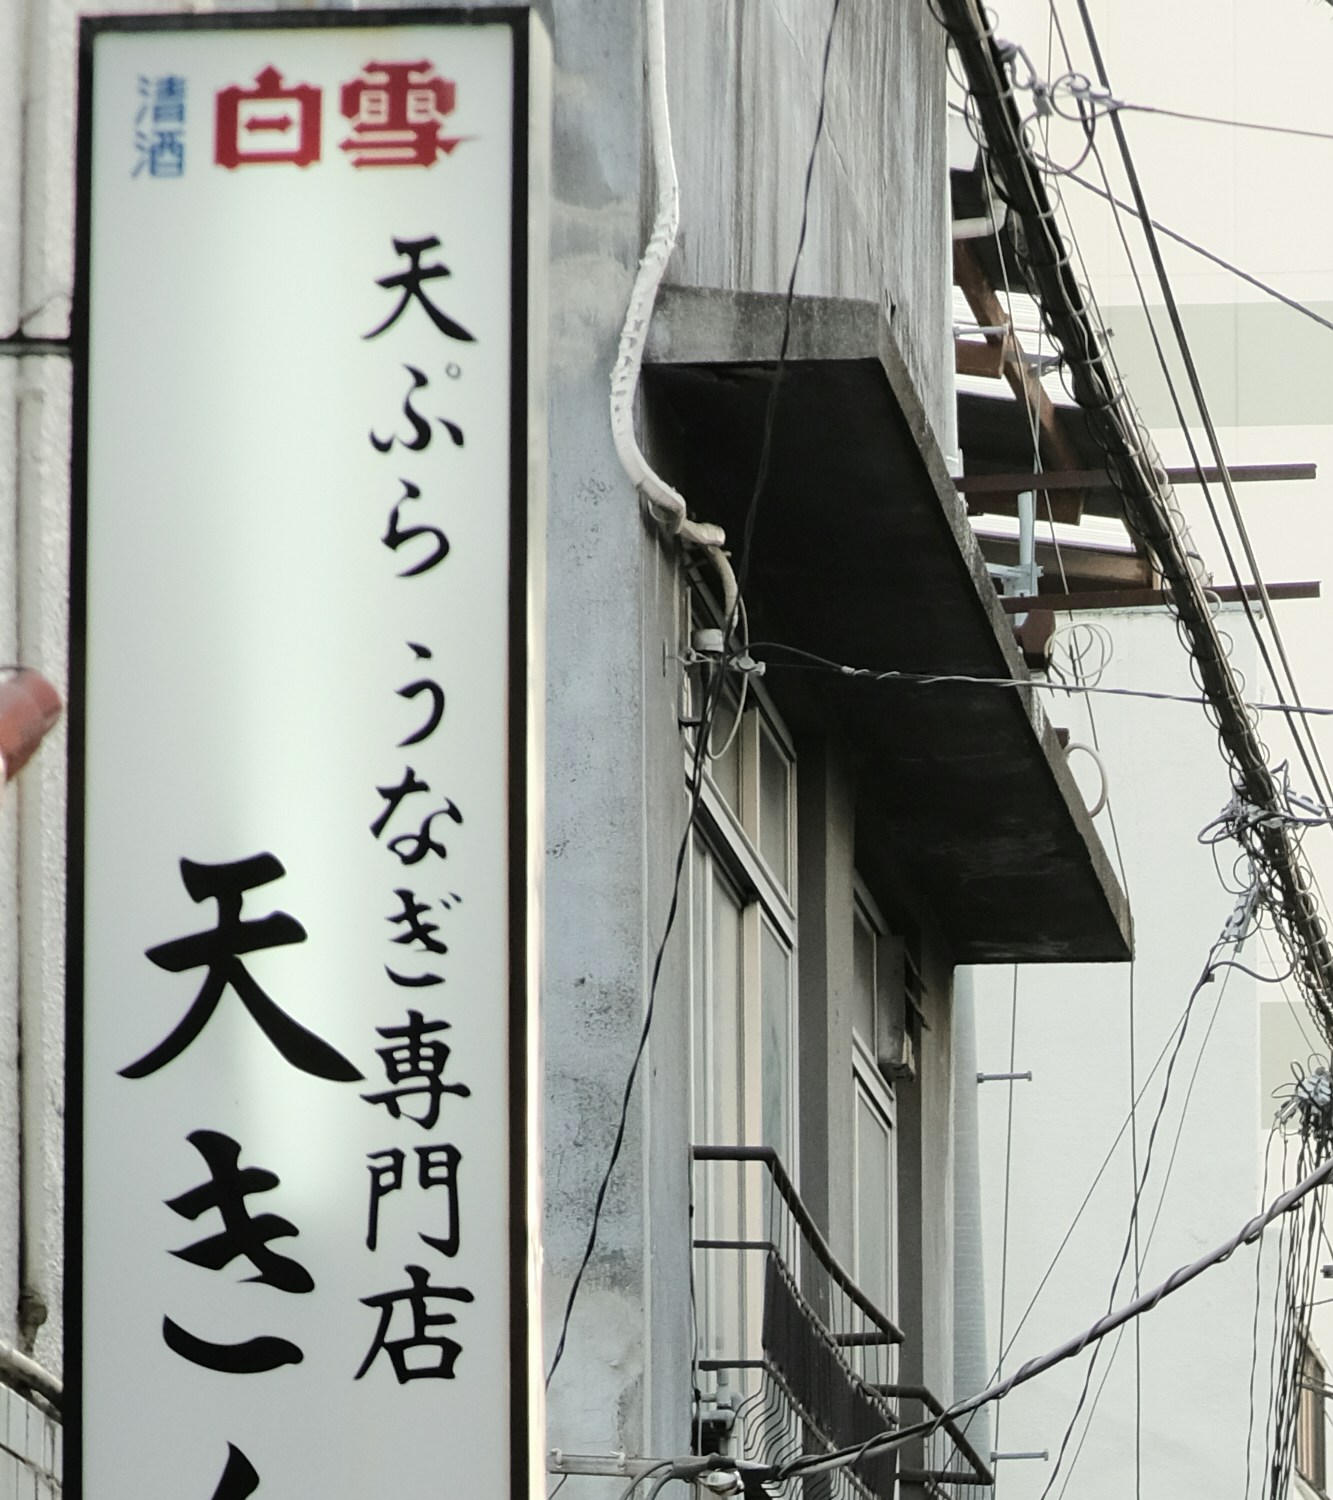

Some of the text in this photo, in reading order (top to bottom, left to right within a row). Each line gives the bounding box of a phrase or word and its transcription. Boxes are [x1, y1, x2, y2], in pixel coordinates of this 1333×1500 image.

[131, 58, 462, 179] 清酒 白雪
[354, 235, 477, 1385] 天ぷら うなぎ専門店
